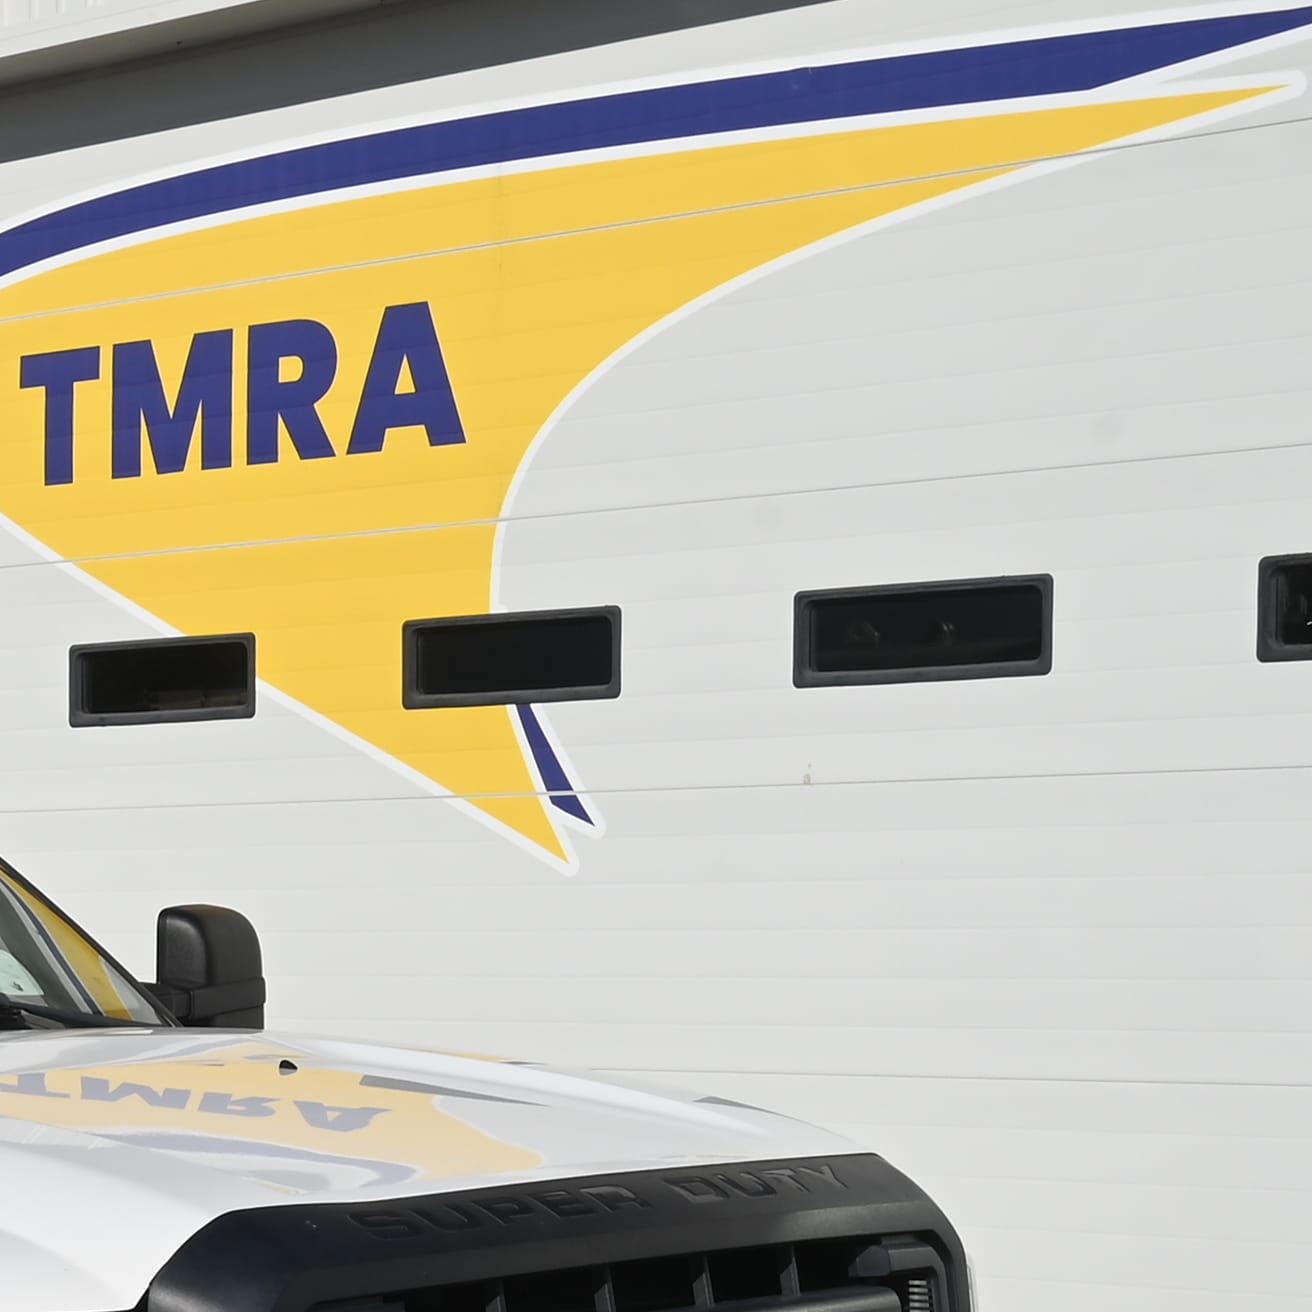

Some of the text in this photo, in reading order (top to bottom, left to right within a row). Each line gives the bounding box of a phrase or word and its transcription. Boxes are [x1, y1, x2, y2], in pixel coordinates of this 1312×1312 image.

[19, 300, 468, 487] TMRA
[346, 1163, 850, 1240] SUPER DUTY
